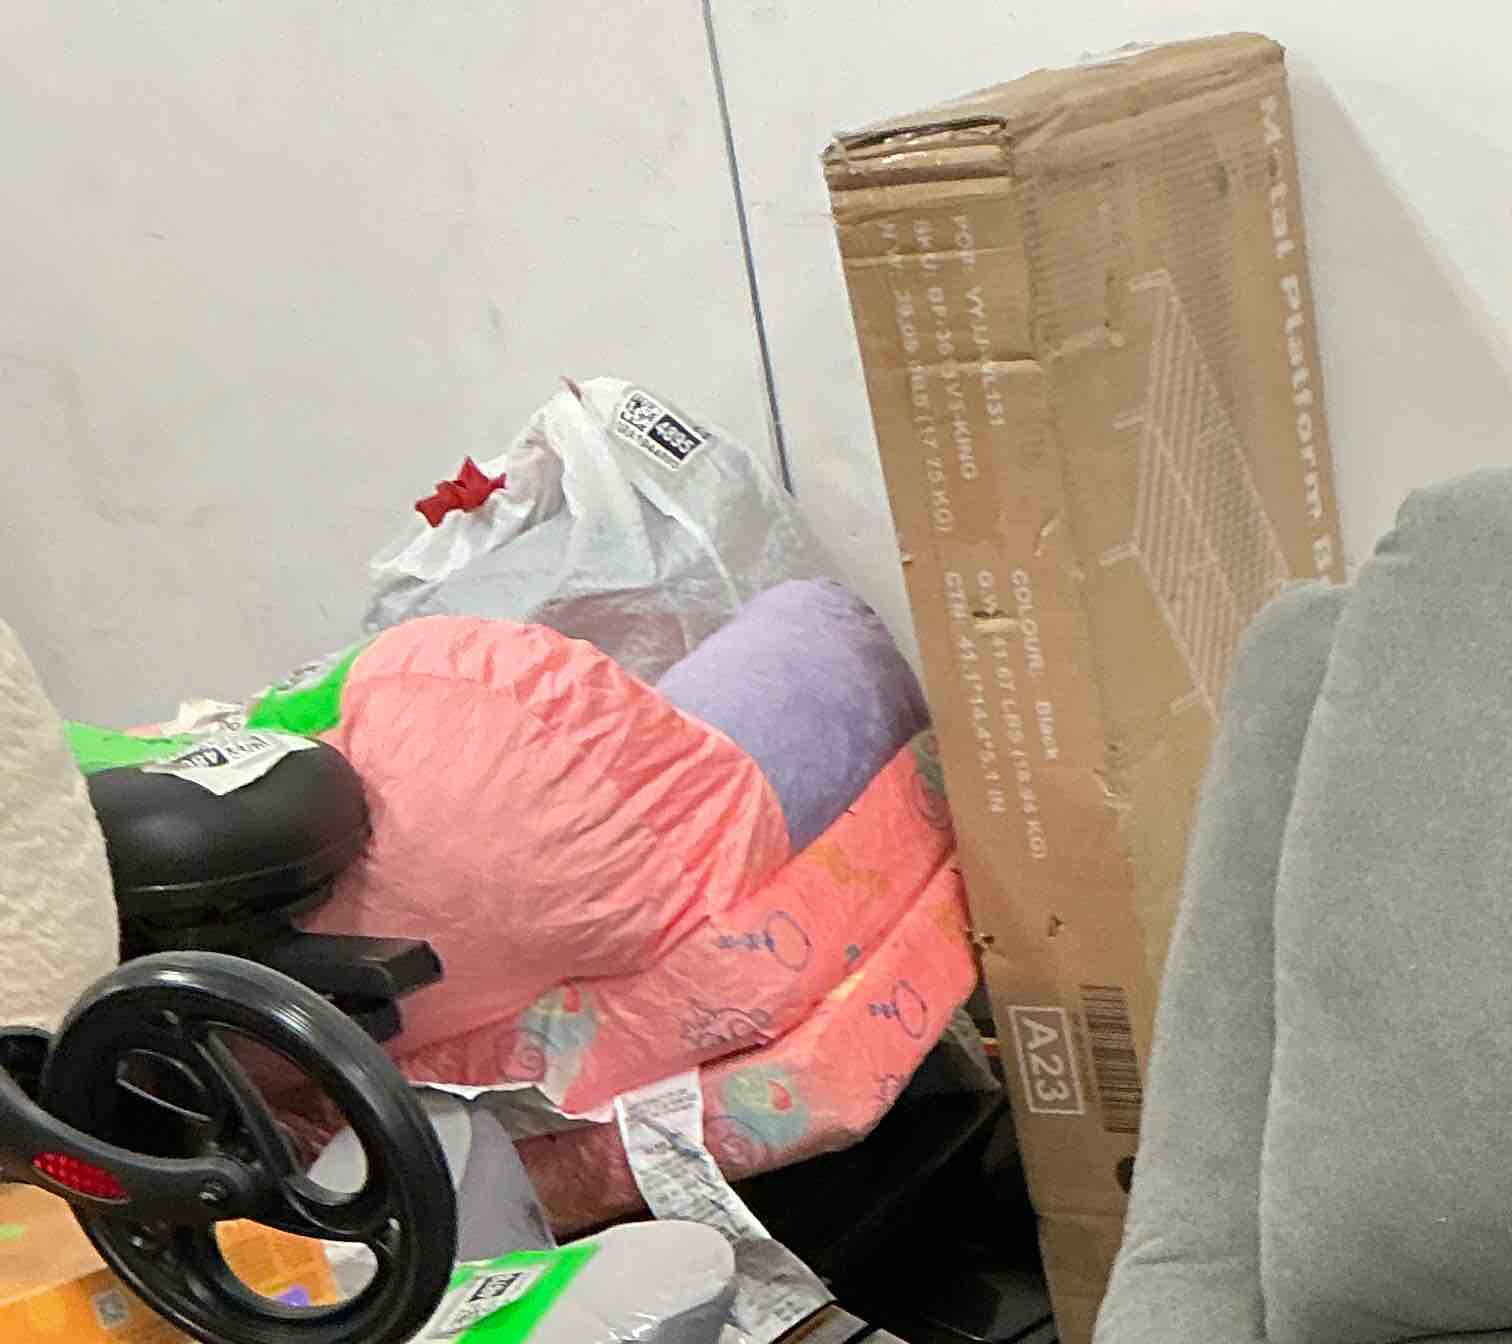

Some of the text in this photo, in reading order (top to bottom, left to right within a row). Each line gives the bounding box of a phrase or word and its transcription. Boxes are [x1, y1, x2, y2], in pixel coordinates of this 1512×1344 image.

[1260, 96, 1295, 259] Mtal
[1280, 274, 1322, 519] Platform
[1036, 701, 1060, 760] Black
[1019, 1016, 1071, 1101] A23
